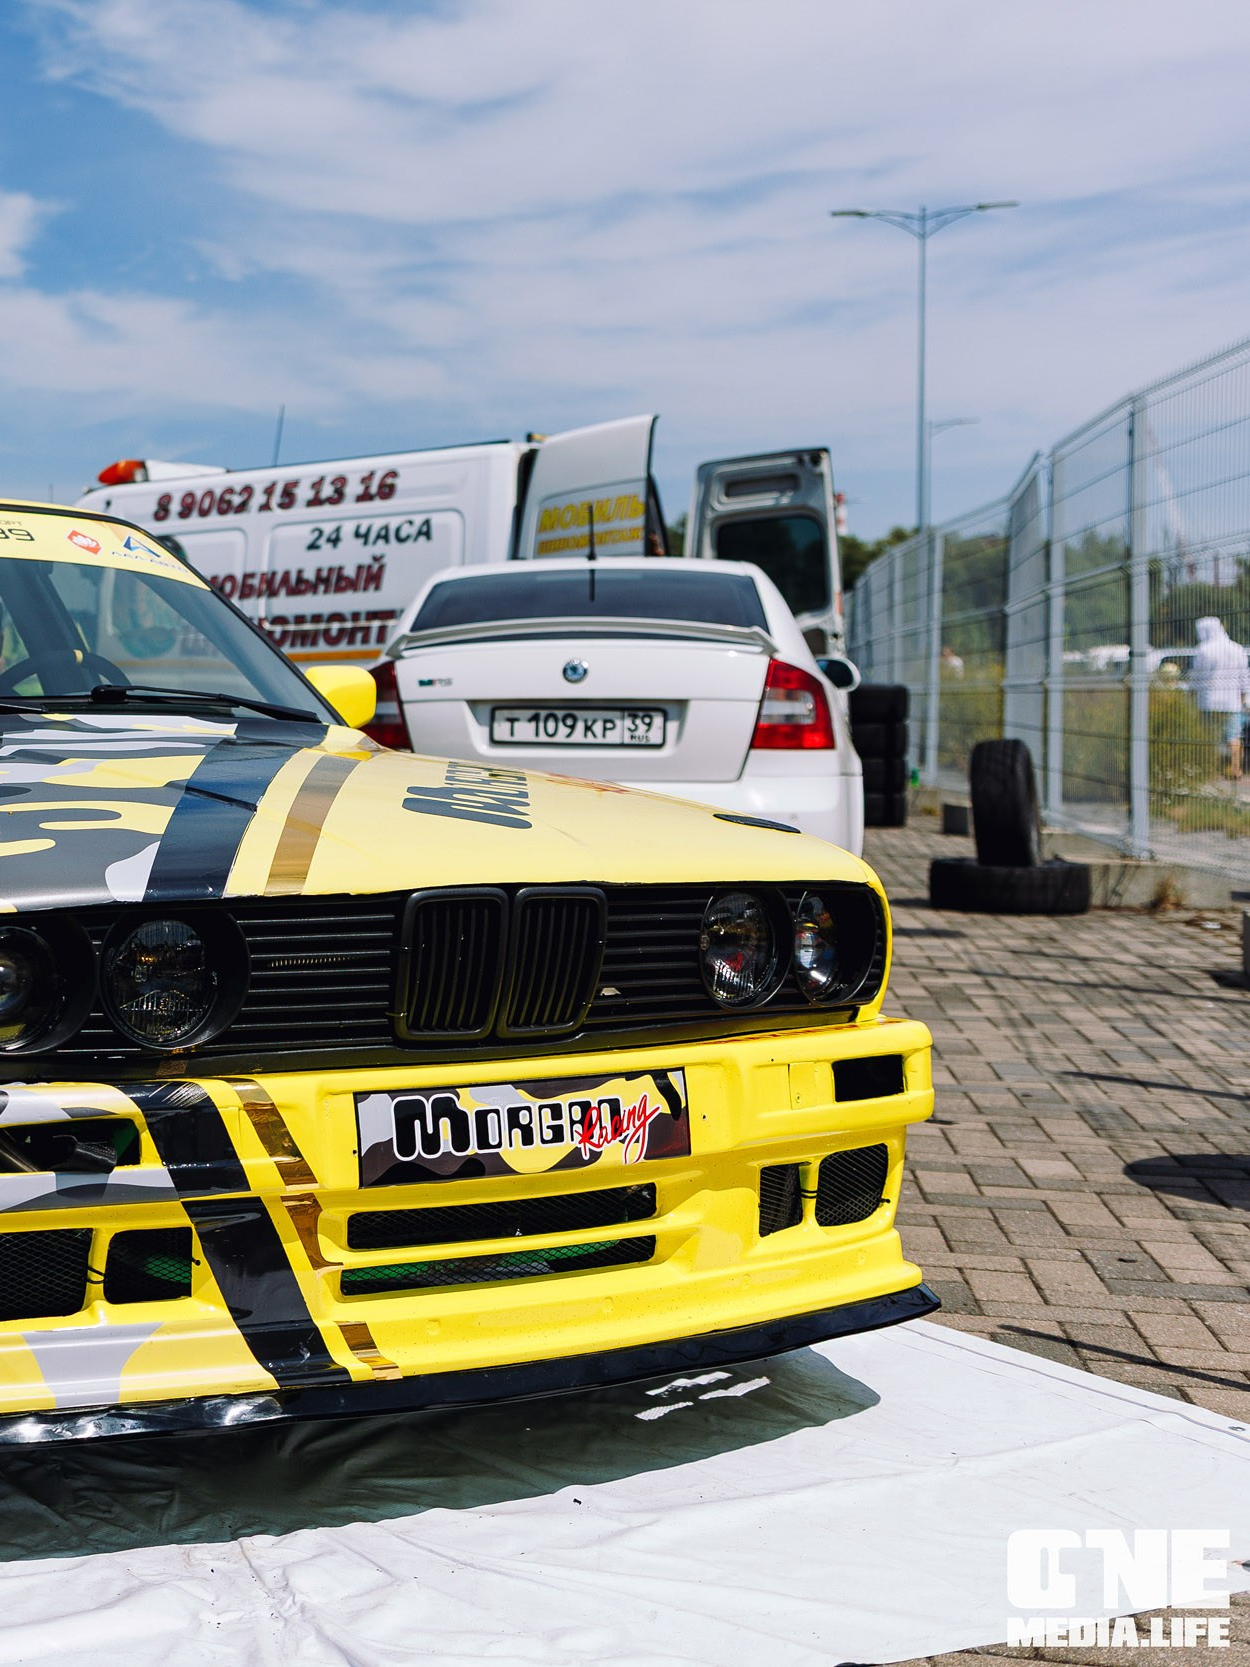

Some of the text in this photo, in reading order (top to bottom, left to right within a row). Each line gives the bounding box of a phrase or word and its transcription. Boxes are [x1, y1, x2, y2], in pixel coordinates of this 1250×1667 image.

[153, 470, 399, 521] 8 9062 15 13 16
[306, 518, 432, 550] 24 ЧАСА
[627, 713, 653, 733] 39
[630, 734, 650, 742] RUS
[573, 1094, 661, 1165] Racing
